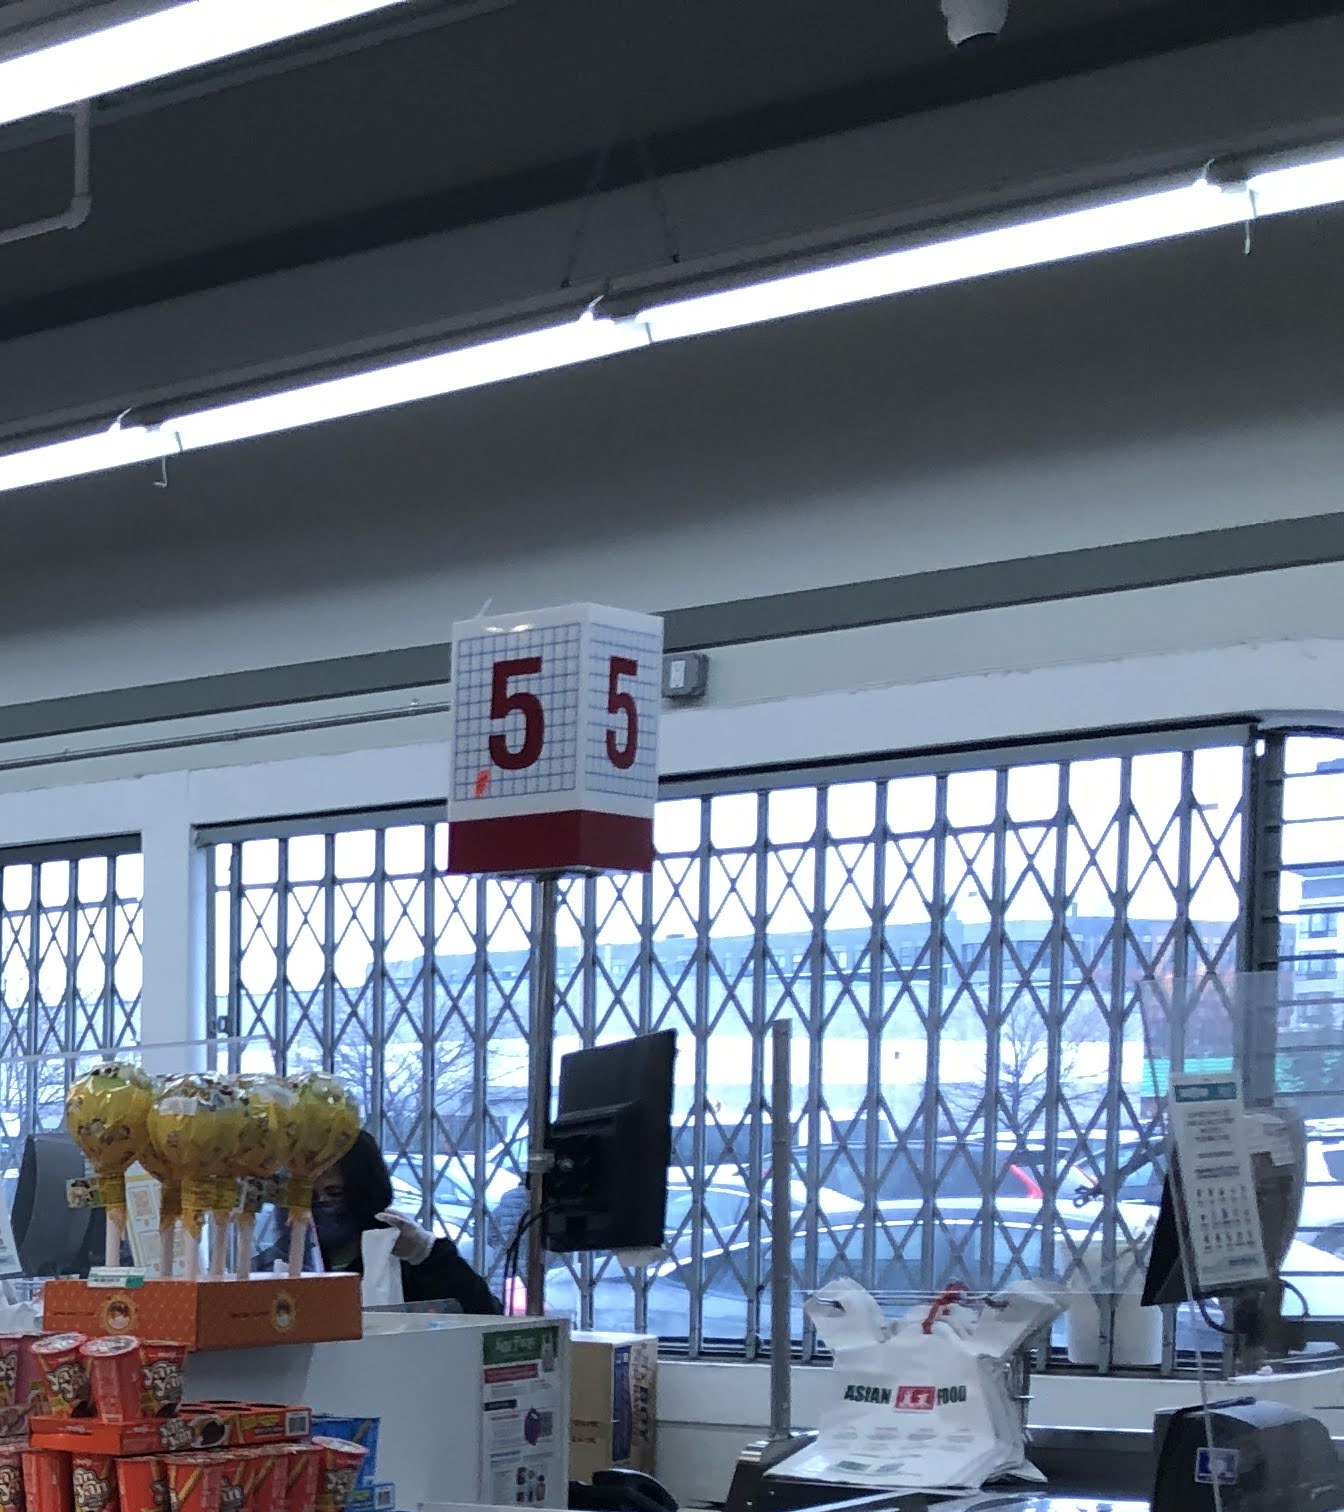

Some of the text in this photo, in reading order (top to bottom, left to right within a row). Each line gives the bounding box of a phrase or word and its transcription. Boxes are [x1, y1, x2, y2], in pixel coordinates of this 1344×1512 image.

[489, 656, 544, 770] 5
[606, 656, 638, 769] 5
[844, 1385, 892, 1404] ASIAN
[937, 1385, 967, 1406] FOOD
